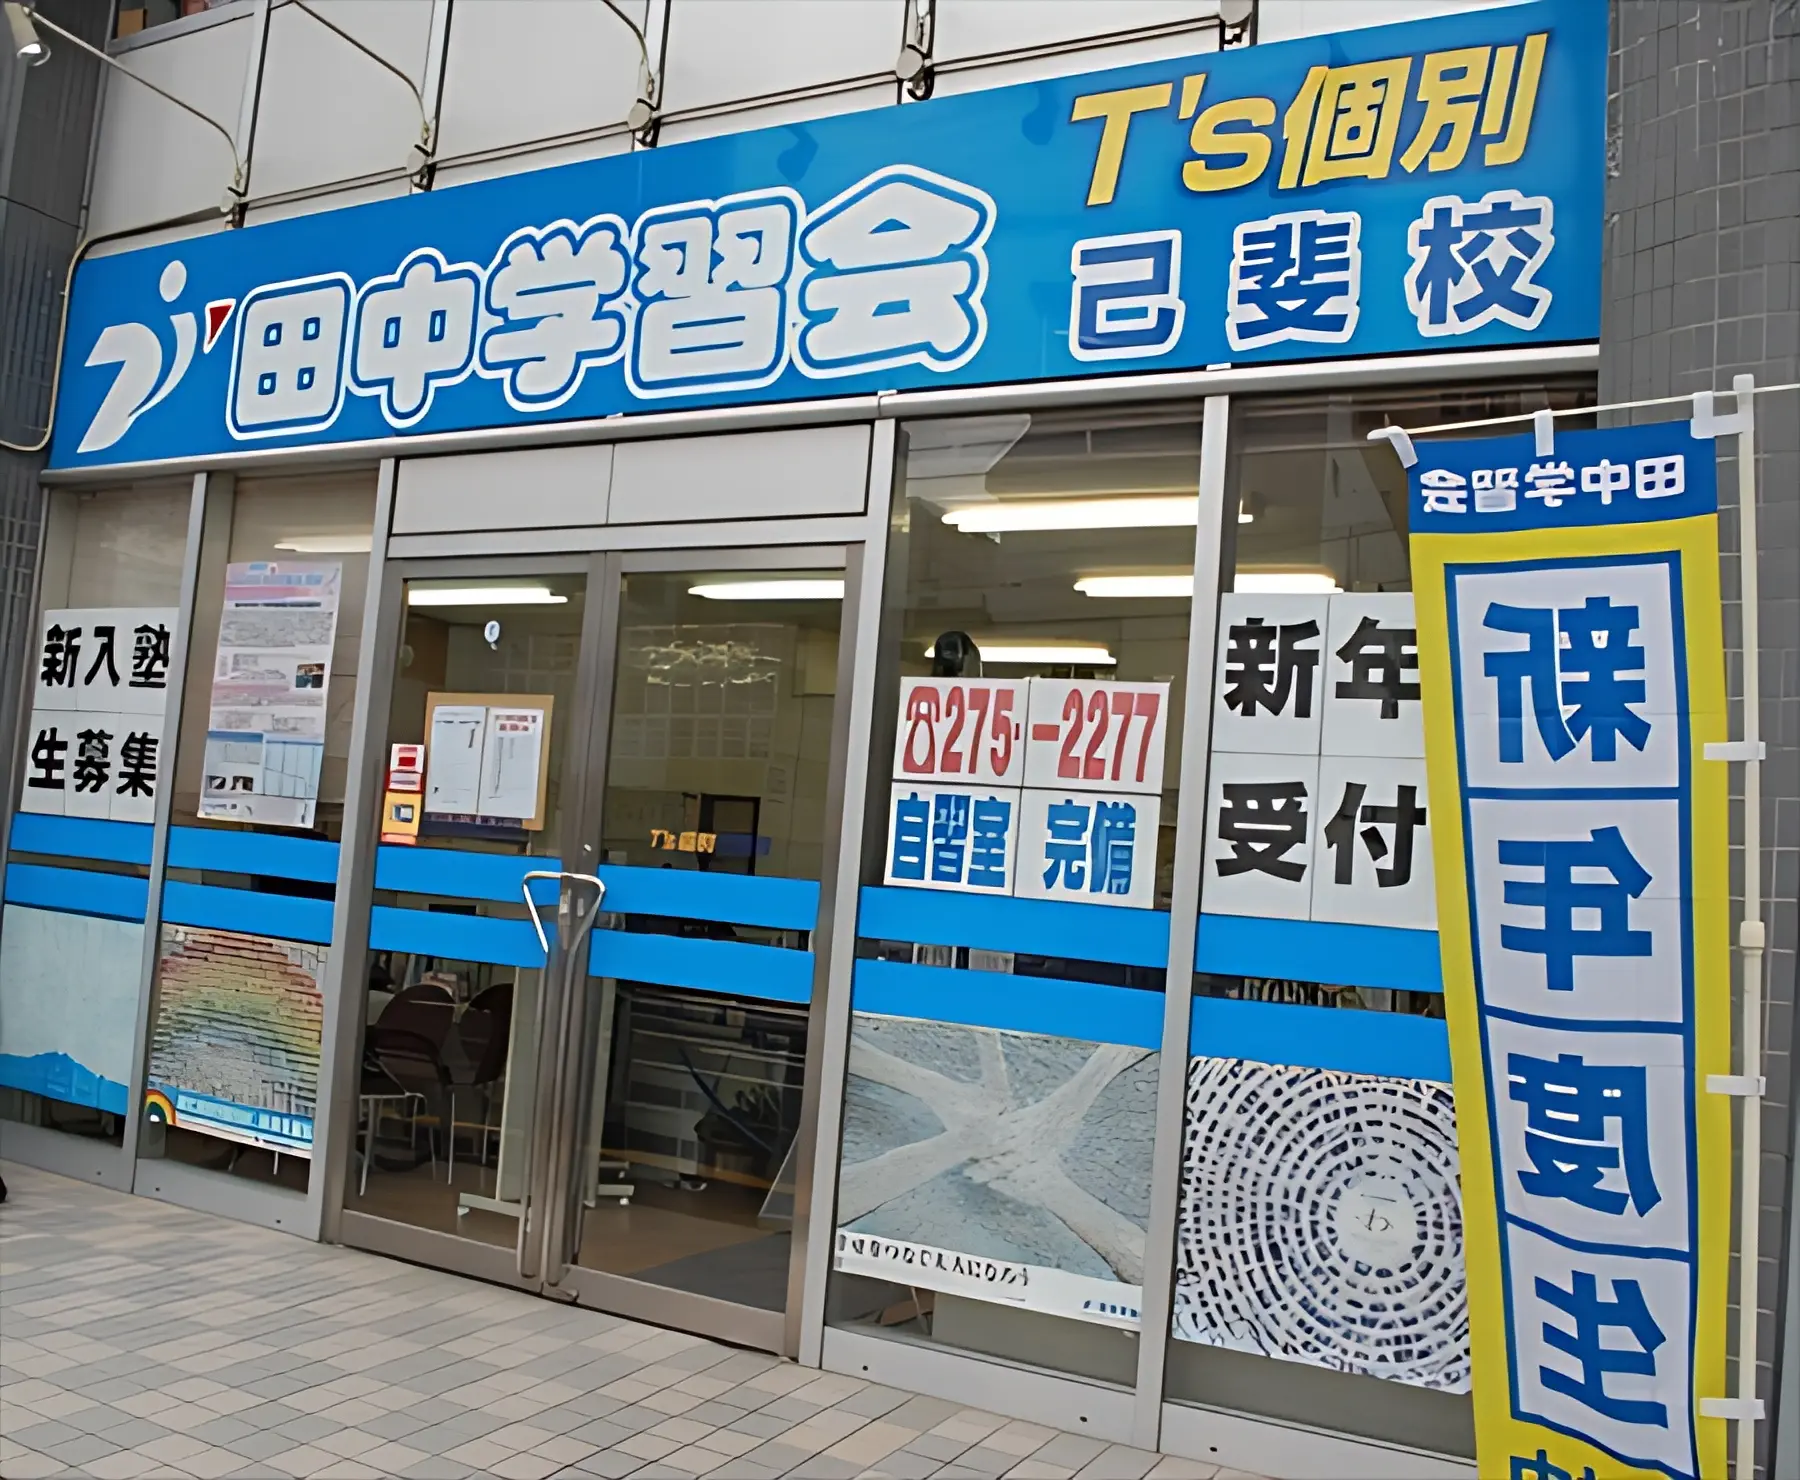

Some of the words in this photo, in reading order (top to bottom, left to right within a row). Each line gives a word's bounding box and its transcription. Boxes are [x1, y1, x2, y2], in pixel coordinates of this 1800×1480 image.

[1070, 33, 1549, 206] T's個別
[226, 163, 997, 441] 田中学習会
[1068, 190, 1555, 362] 己斐校
[40, 623, 171, 688] 新入塾
[1223, 616, 1421, 719] 新年
[28, 727, 160, 797] 生募集
[1216, 781, 1427, 888] 受付
